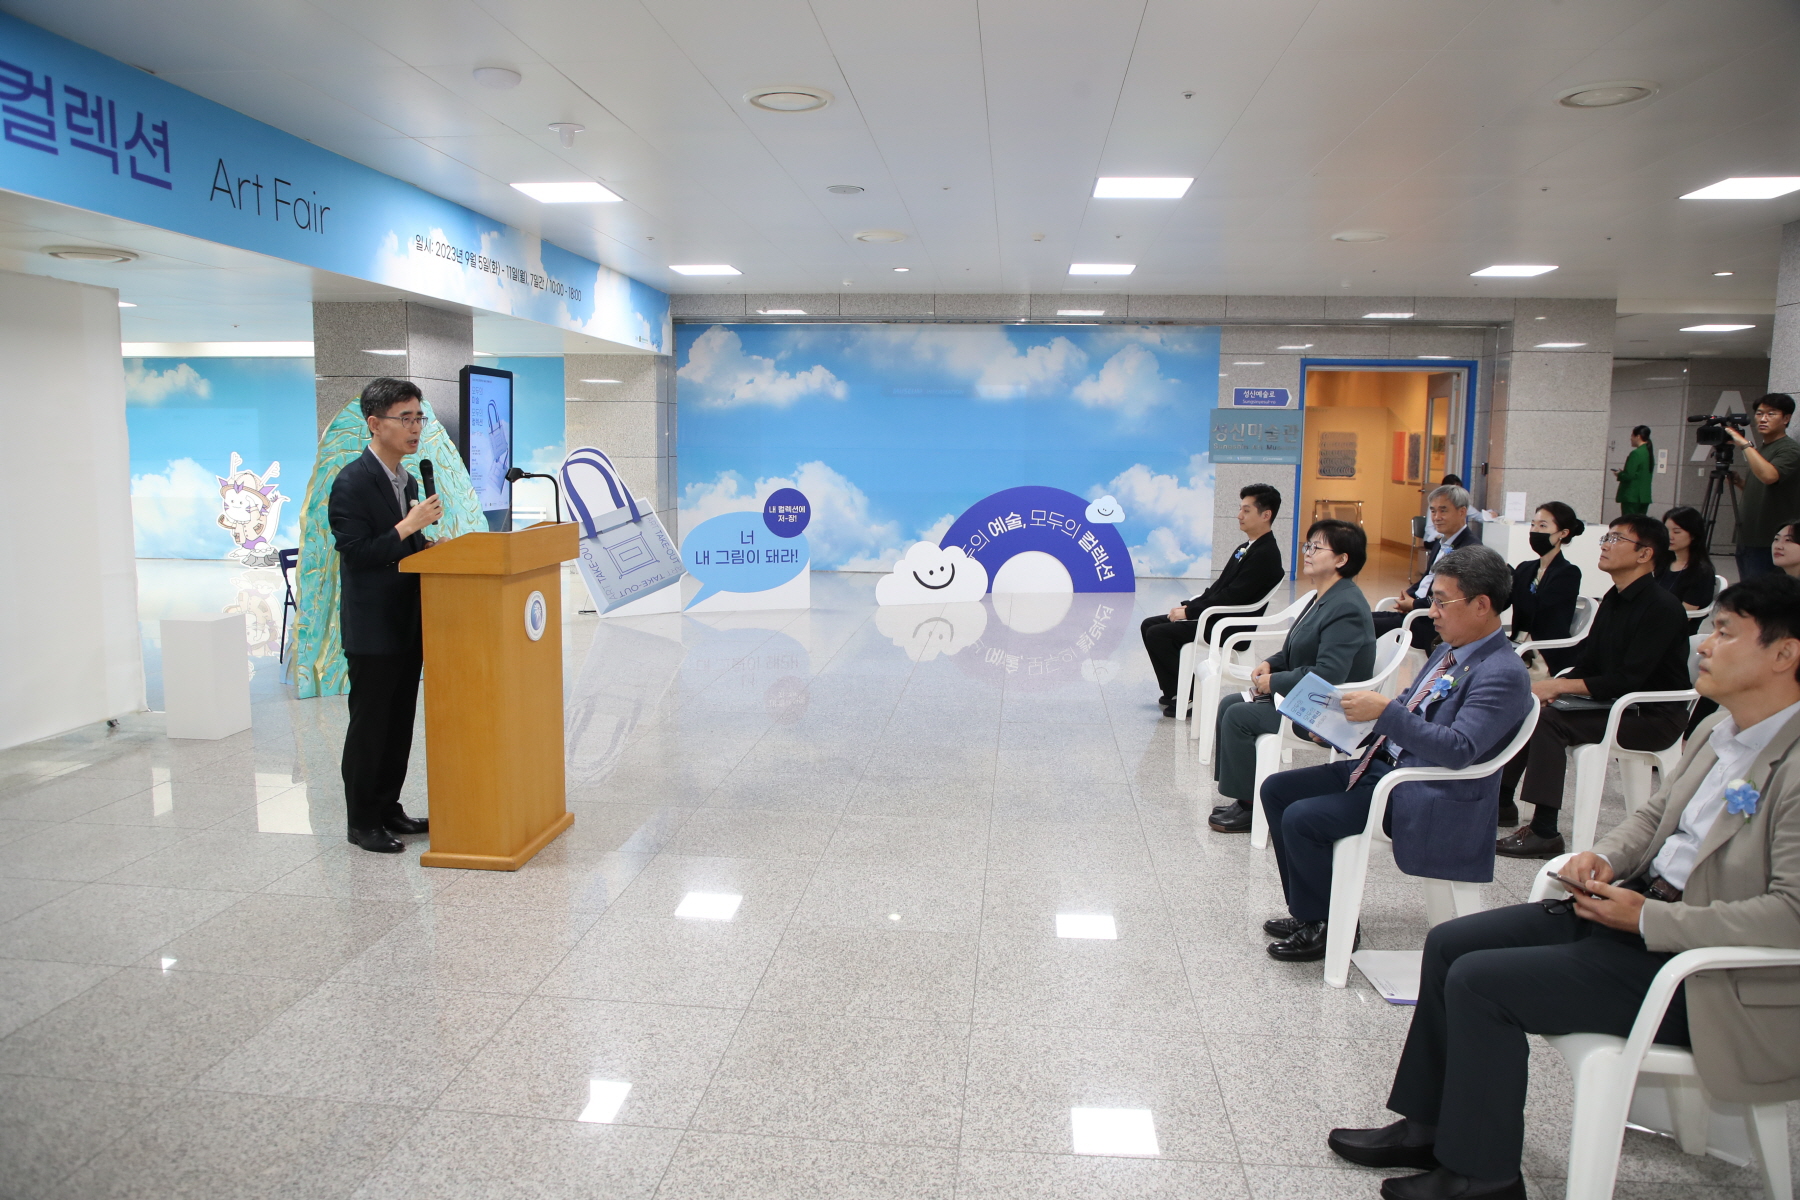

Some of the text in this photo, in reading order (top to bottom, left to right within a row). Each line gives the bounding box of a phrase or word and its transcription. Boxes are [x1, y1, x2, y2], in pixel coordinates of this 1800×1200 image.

[0, 58, 331, 235] 컬렉션 Art Fair
[415, 235, 434, 255] 일시:
[436, 241, 463, 264] 2023년
[465, 251, 477, 268] 9월
[478, 255, 500, 277] 5일(화)
[530, 273, 544, 290] 7일간
[549, 279, 564, 297] 10:00
[1243, 390, 1276, 399] 성신예술로
[1212, 423, 1300, 443] 성신미술관
[769, 505, 806, 514] 내 컬렉션에
[778, 514, 797, 523] 저-장!
[646, 517, 681, 564] ART TAKE-OUT
[741, 530, 754, 545] 너
[987, 511, 1026, 537] 예술,
[1030, 509, 1082, 539] 모두의
[1078, 530, 1116, 582] 컬렉션
[695, 549, 798, 565] 내 그림이 돼라!
[619, 573, 666, 598] TAKE-OUT
